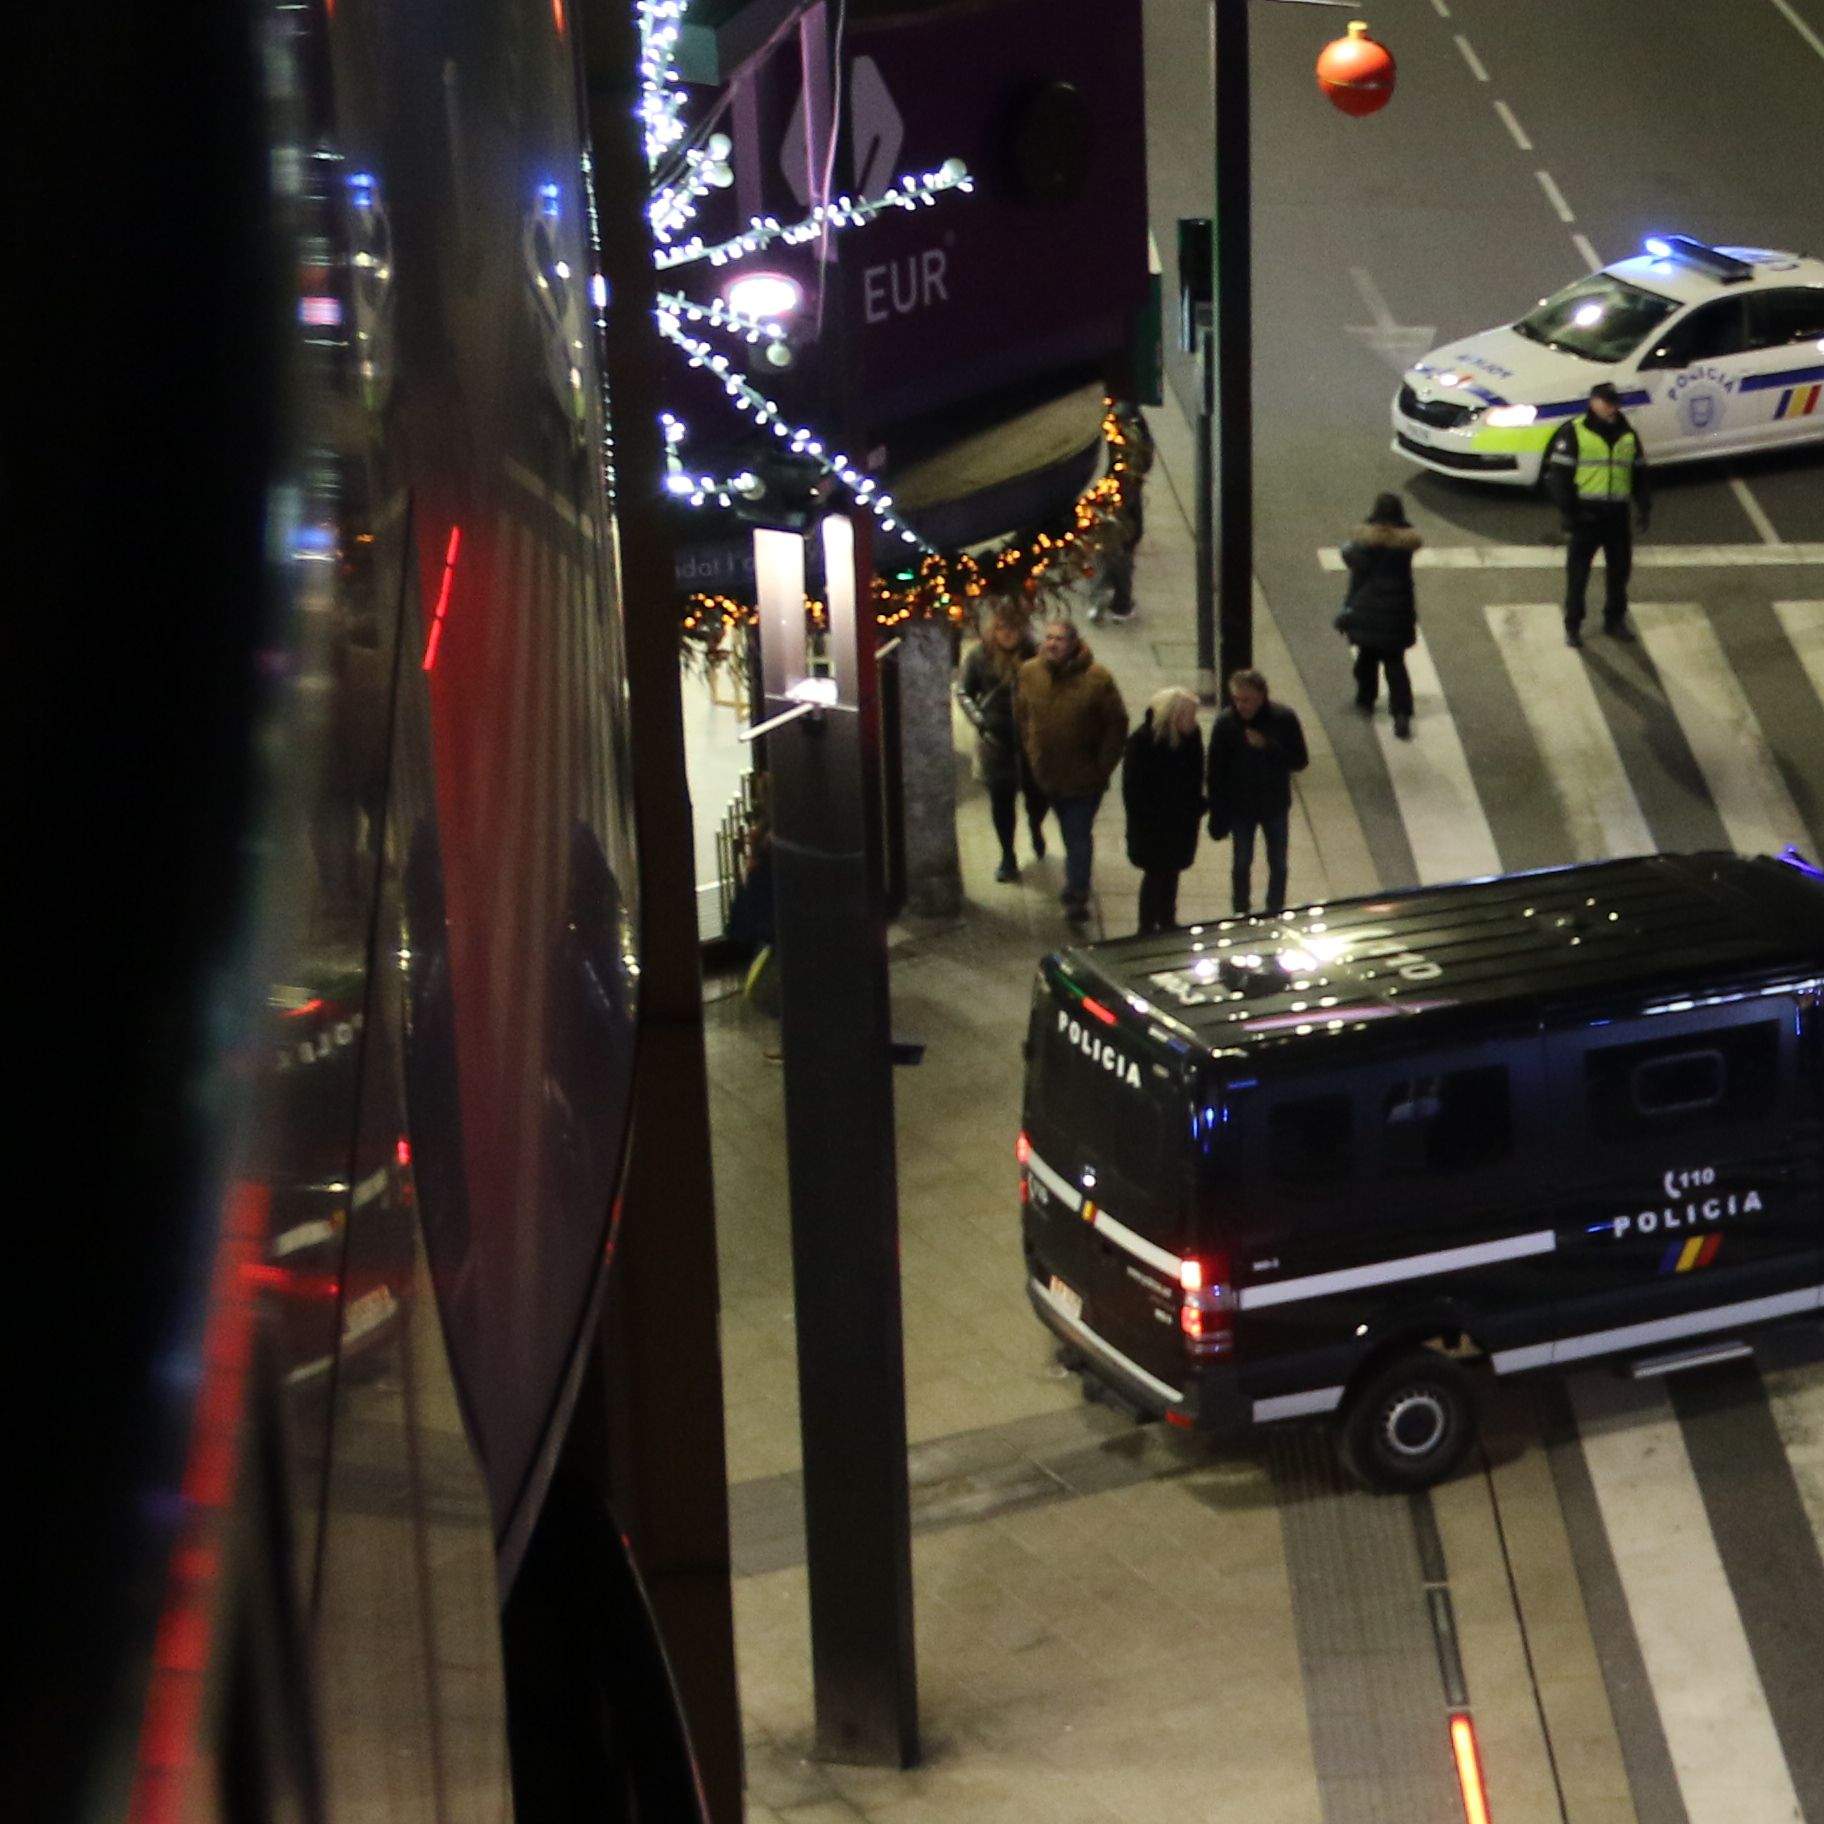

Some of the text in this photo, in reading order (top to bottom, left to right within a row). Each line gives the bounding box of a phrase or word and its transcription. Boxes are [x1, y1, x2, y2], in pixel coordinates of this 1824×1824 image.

[1057, 1009, 1142, 1089] POLICIA
[1678, 1165, 1716, 1190] 110
[1613, 1189, 1763, 1240] POLICIA
